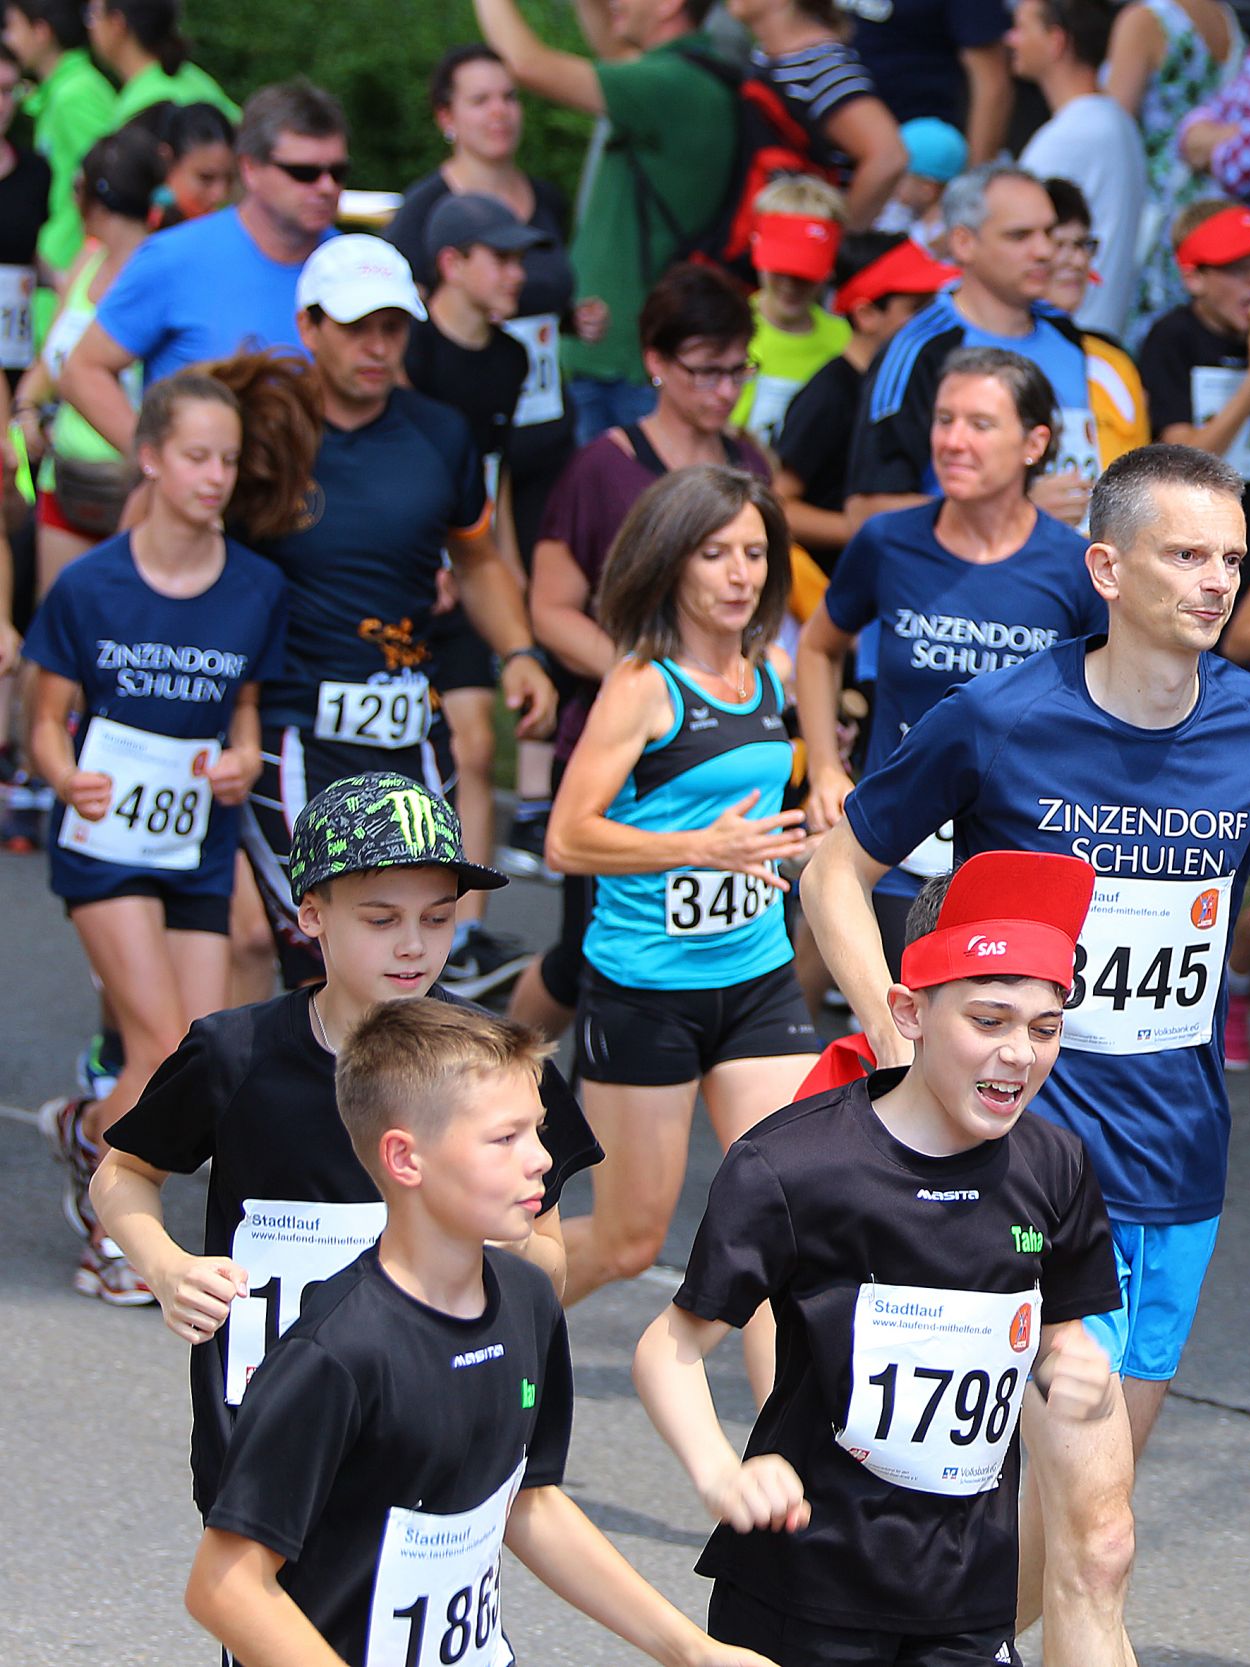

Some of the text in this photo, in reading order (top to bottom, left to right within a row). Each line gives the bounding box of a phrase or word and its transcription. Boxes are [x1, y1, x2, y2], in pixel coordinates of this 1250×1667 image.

[895, 609, 1059, 652] ZINZENDORF
[96, 640, 248, 679] ZINZENDORF
[115, 667, 227, 703] SCHULEN
[327, 692, 426, 740] 1291
[1038, 798, 1248, 841] ZINZENDORF
[1071, 838, 1226, 876] SCHULEN
[1092, 890, 1121, 903] lauf
[977, 941, 1008, 957] SAS
[251, 1213, 321, 1231] Stadtlauf
[251, 1230, 376, 1246] www.laufend-mithelfen.d
[1010, 1225, 1044, 1253] Taha
[874, 1299, 945, 1318] Stadtlauf
[872, 1318, 992, 1336] www.laufend-mithelfen.de
[868, 1362, 1019, 1447] 1798
